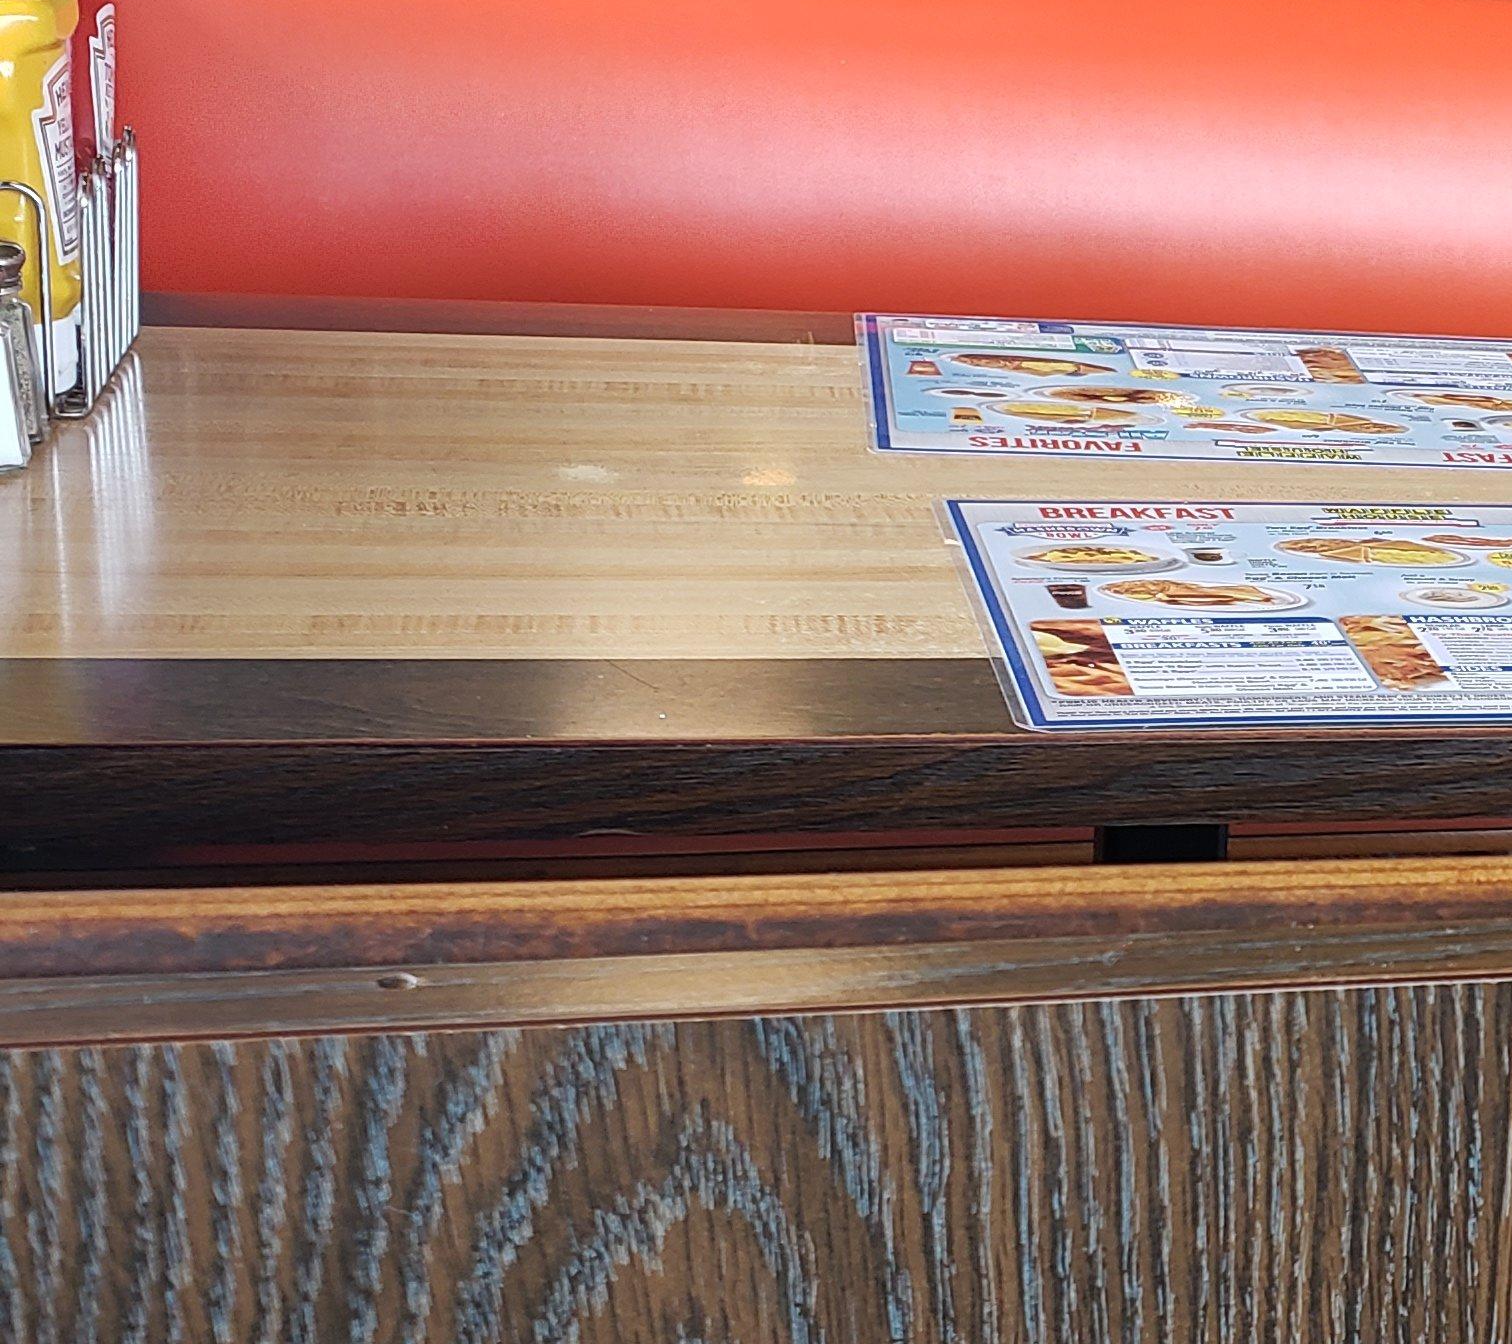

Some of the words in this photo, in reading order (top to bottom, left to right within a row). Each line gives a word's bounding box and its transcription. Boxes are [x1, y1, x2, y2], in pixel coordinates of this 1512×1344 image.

[969, 436, 1142, 452] FAVORITES
[1237, 451, 1362, 460] WAFFLE
[1038, 507, 1235, 520] BREAKFAST
[1120, 641, 1242, 649] BREAKFASTS
